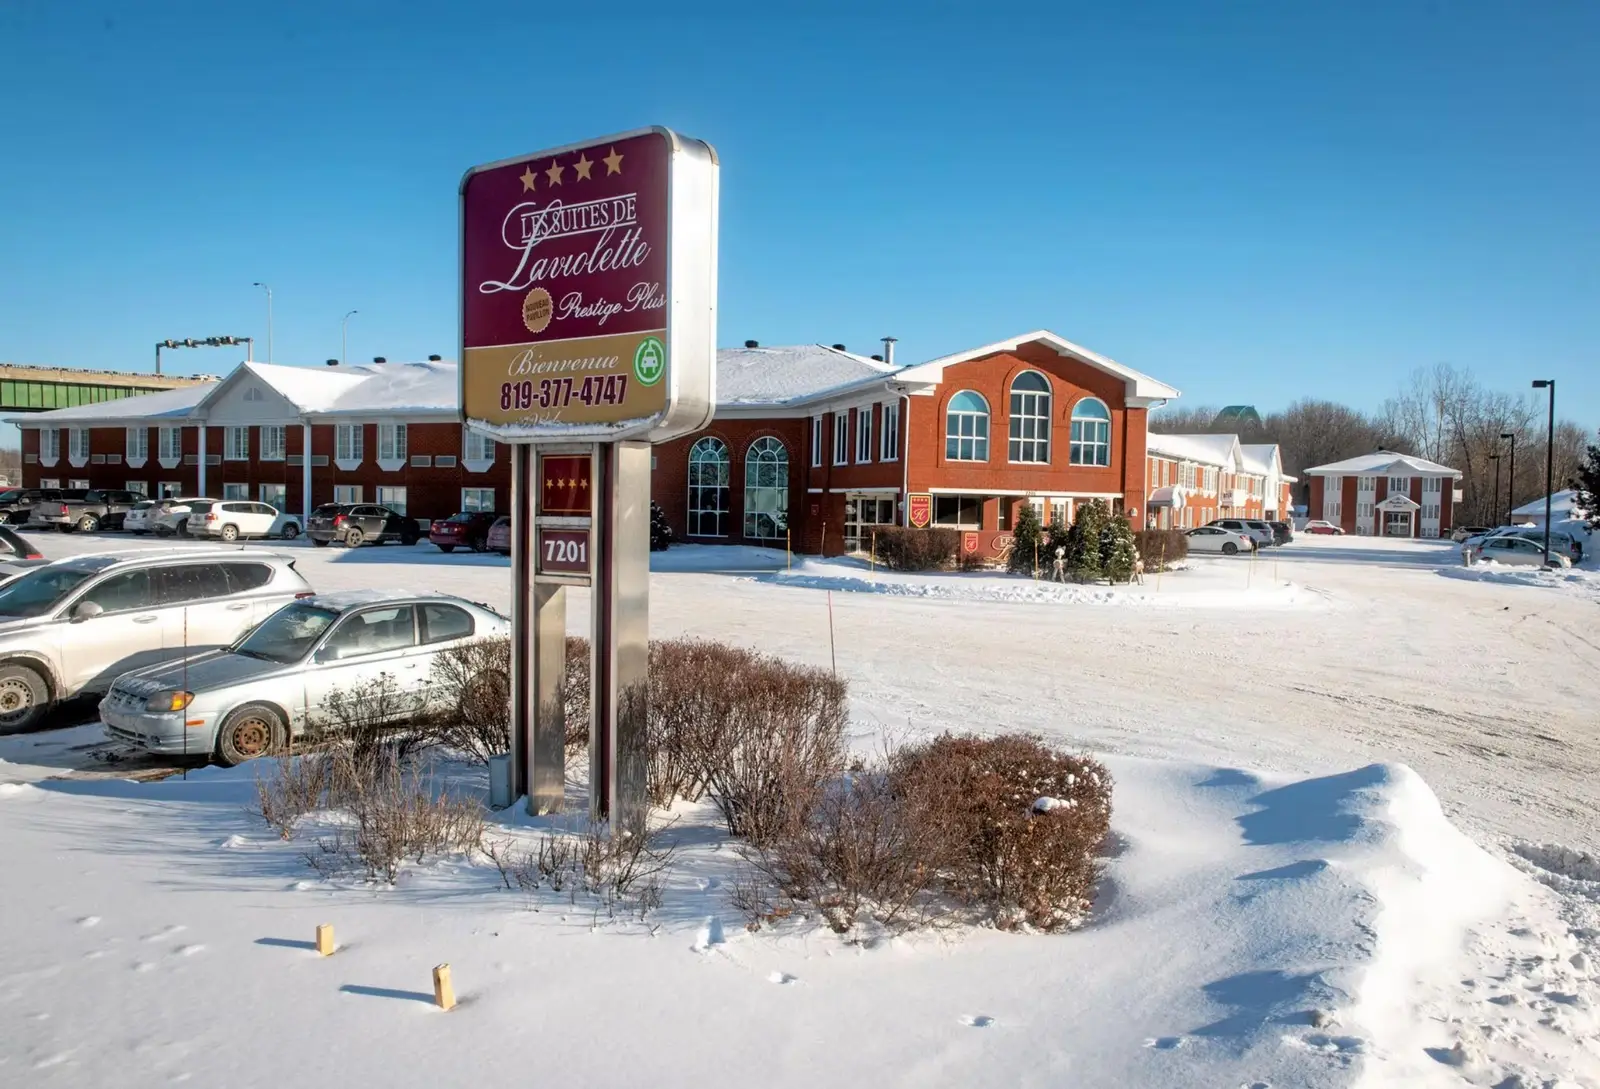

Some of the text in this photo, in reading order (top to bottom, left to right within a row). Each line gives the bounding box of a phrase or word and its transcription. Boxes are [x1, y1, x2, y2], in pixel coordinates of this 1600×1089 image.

[521, 196, 637, 239] LES SUITES DE
[479, 199, 652, 294] Laviolette
[556, 281, 667, 326] Prestige Plus
[508, 345, 619, 377] Bienvenue
[500, 373, 628, 411] 819-377-4747
[544, 539, 587, 563] 7201
